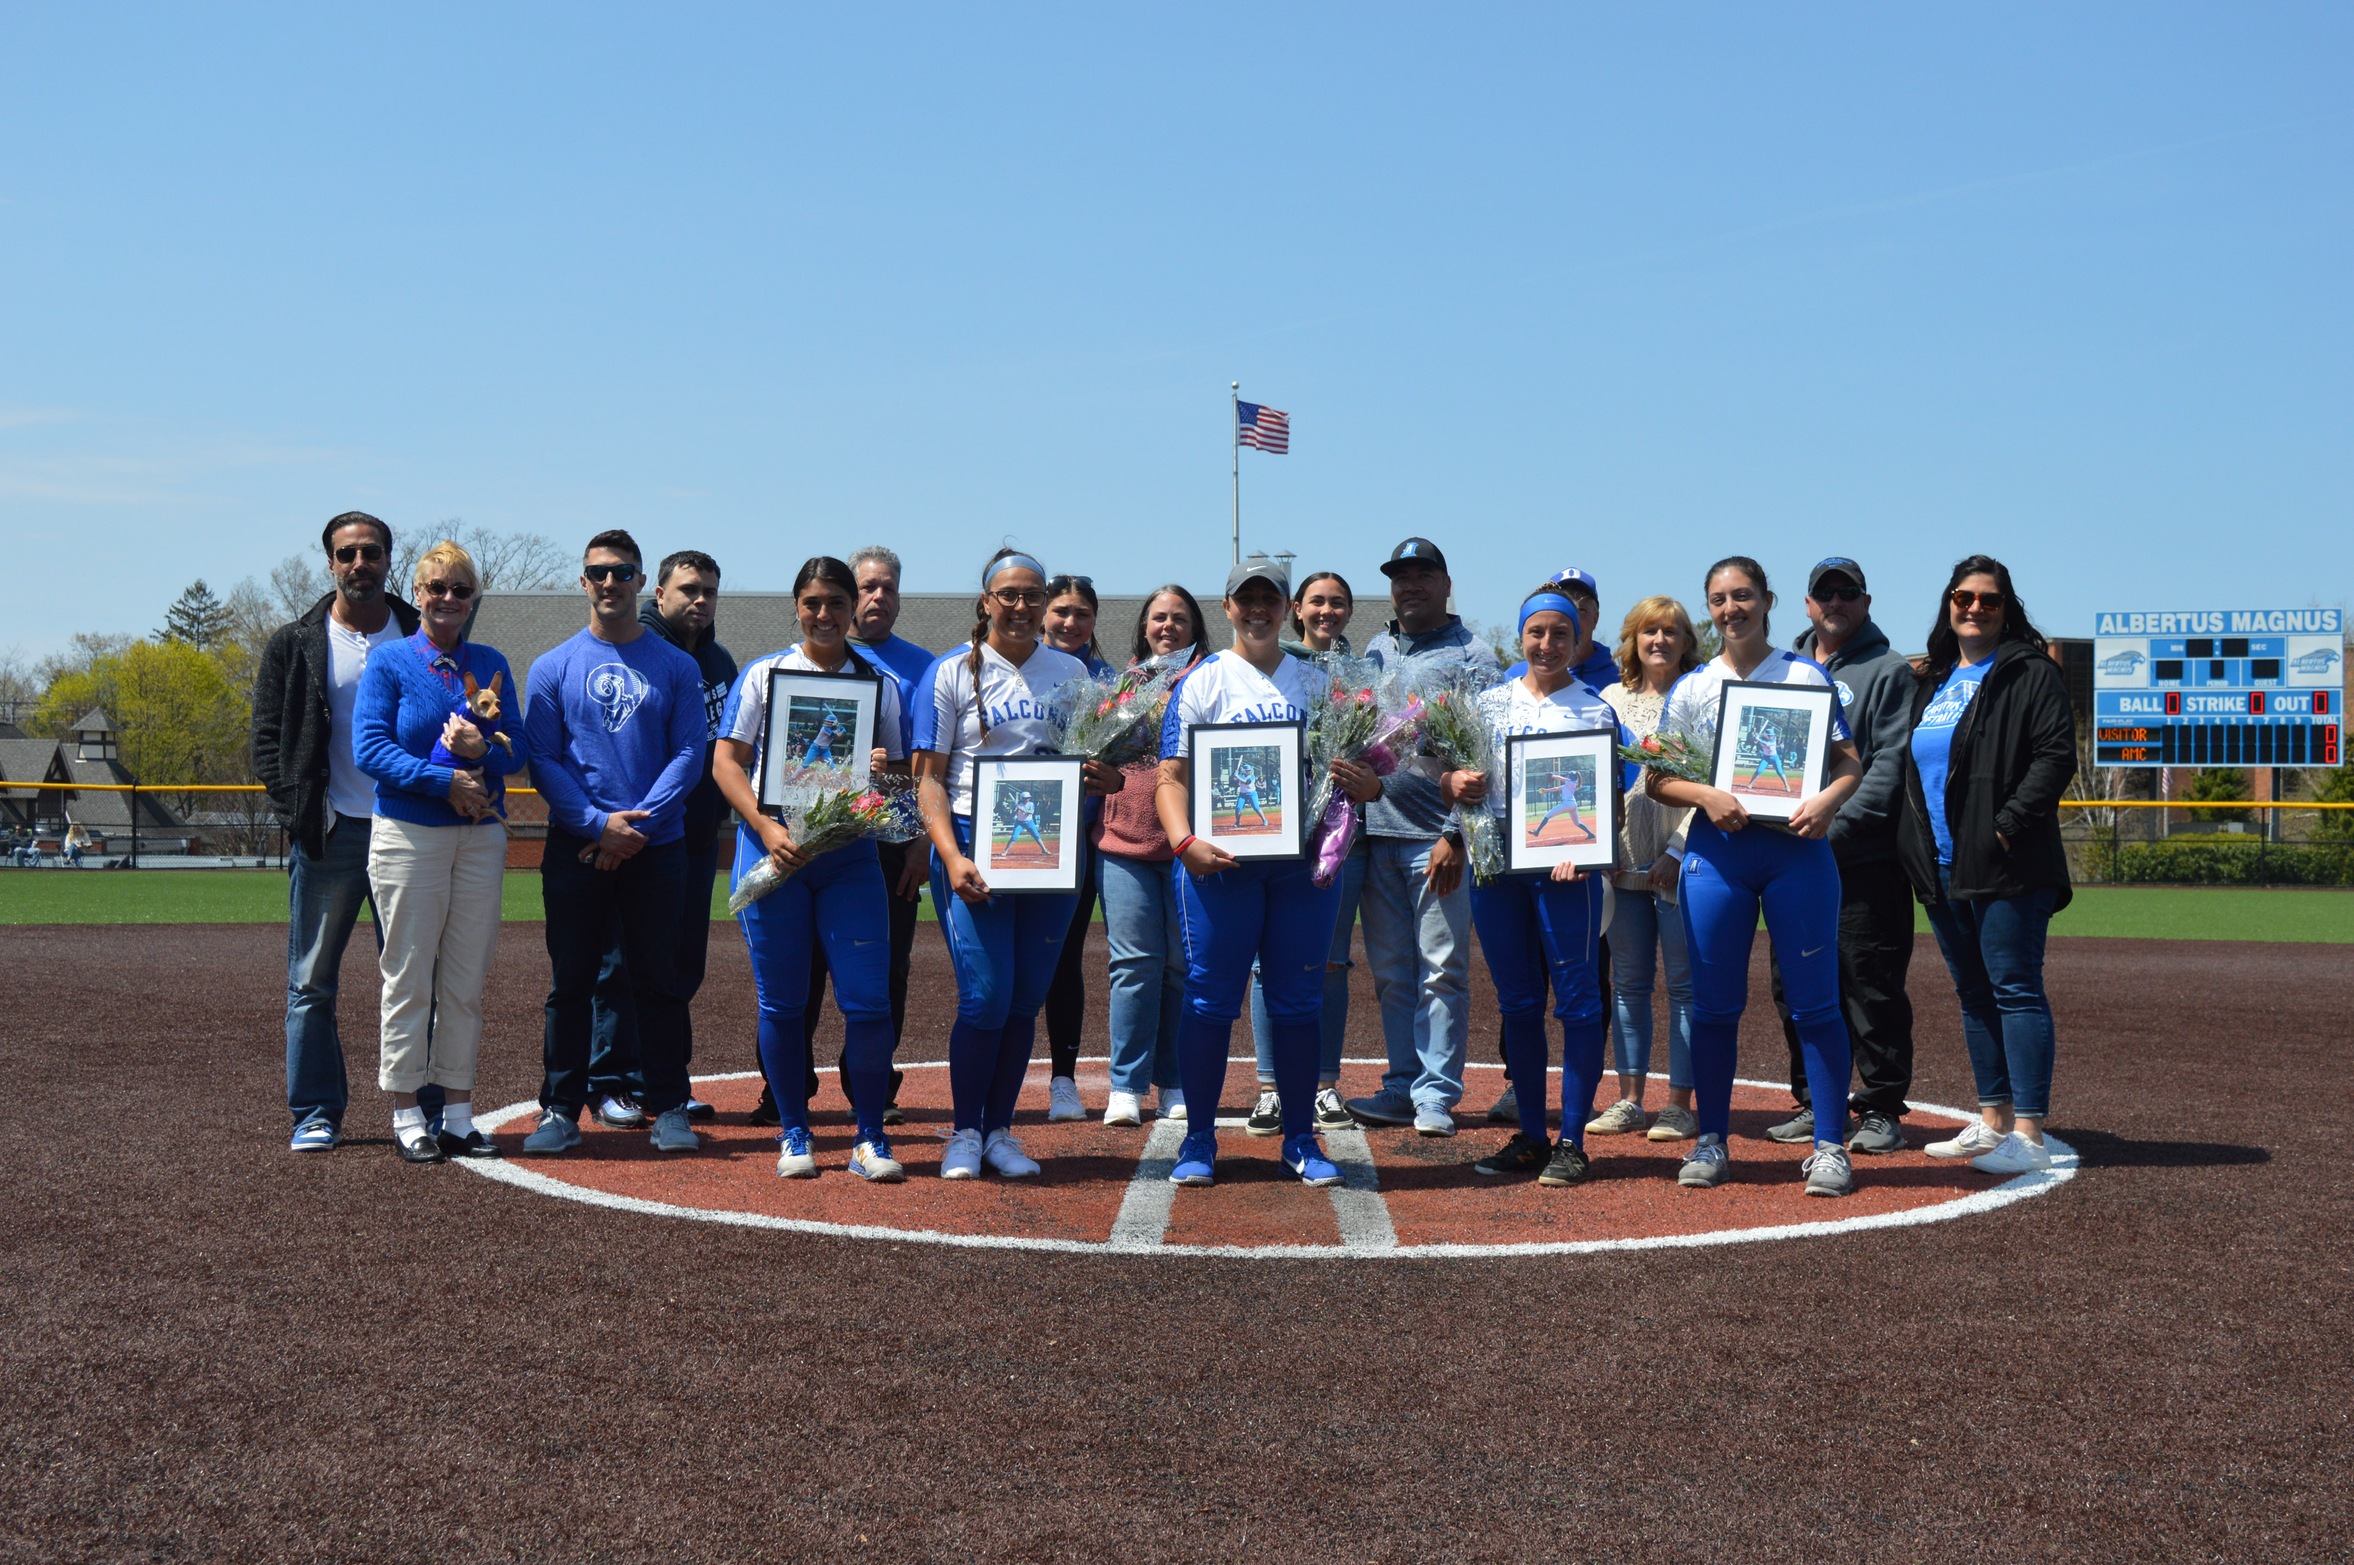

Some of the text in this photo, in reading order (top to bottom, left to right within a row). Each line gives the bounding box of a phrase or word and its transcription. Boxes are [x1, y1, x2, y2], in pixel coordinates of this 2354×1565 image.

[2099, 611, 2338, 634] ALBERTUS MAGNUS
[2158, 679, 2181, 687] HOME
[2253, 679, 2278, 687] GUEST
[2120, 691, 2329, 715] BALL 0 STRIKE 0 OUT 0
[2311, 717, 2338, 725] TOTAL
[2098, 728, 2147, 741] VISITOR
[2121, 747, 2147, 761] AMC
